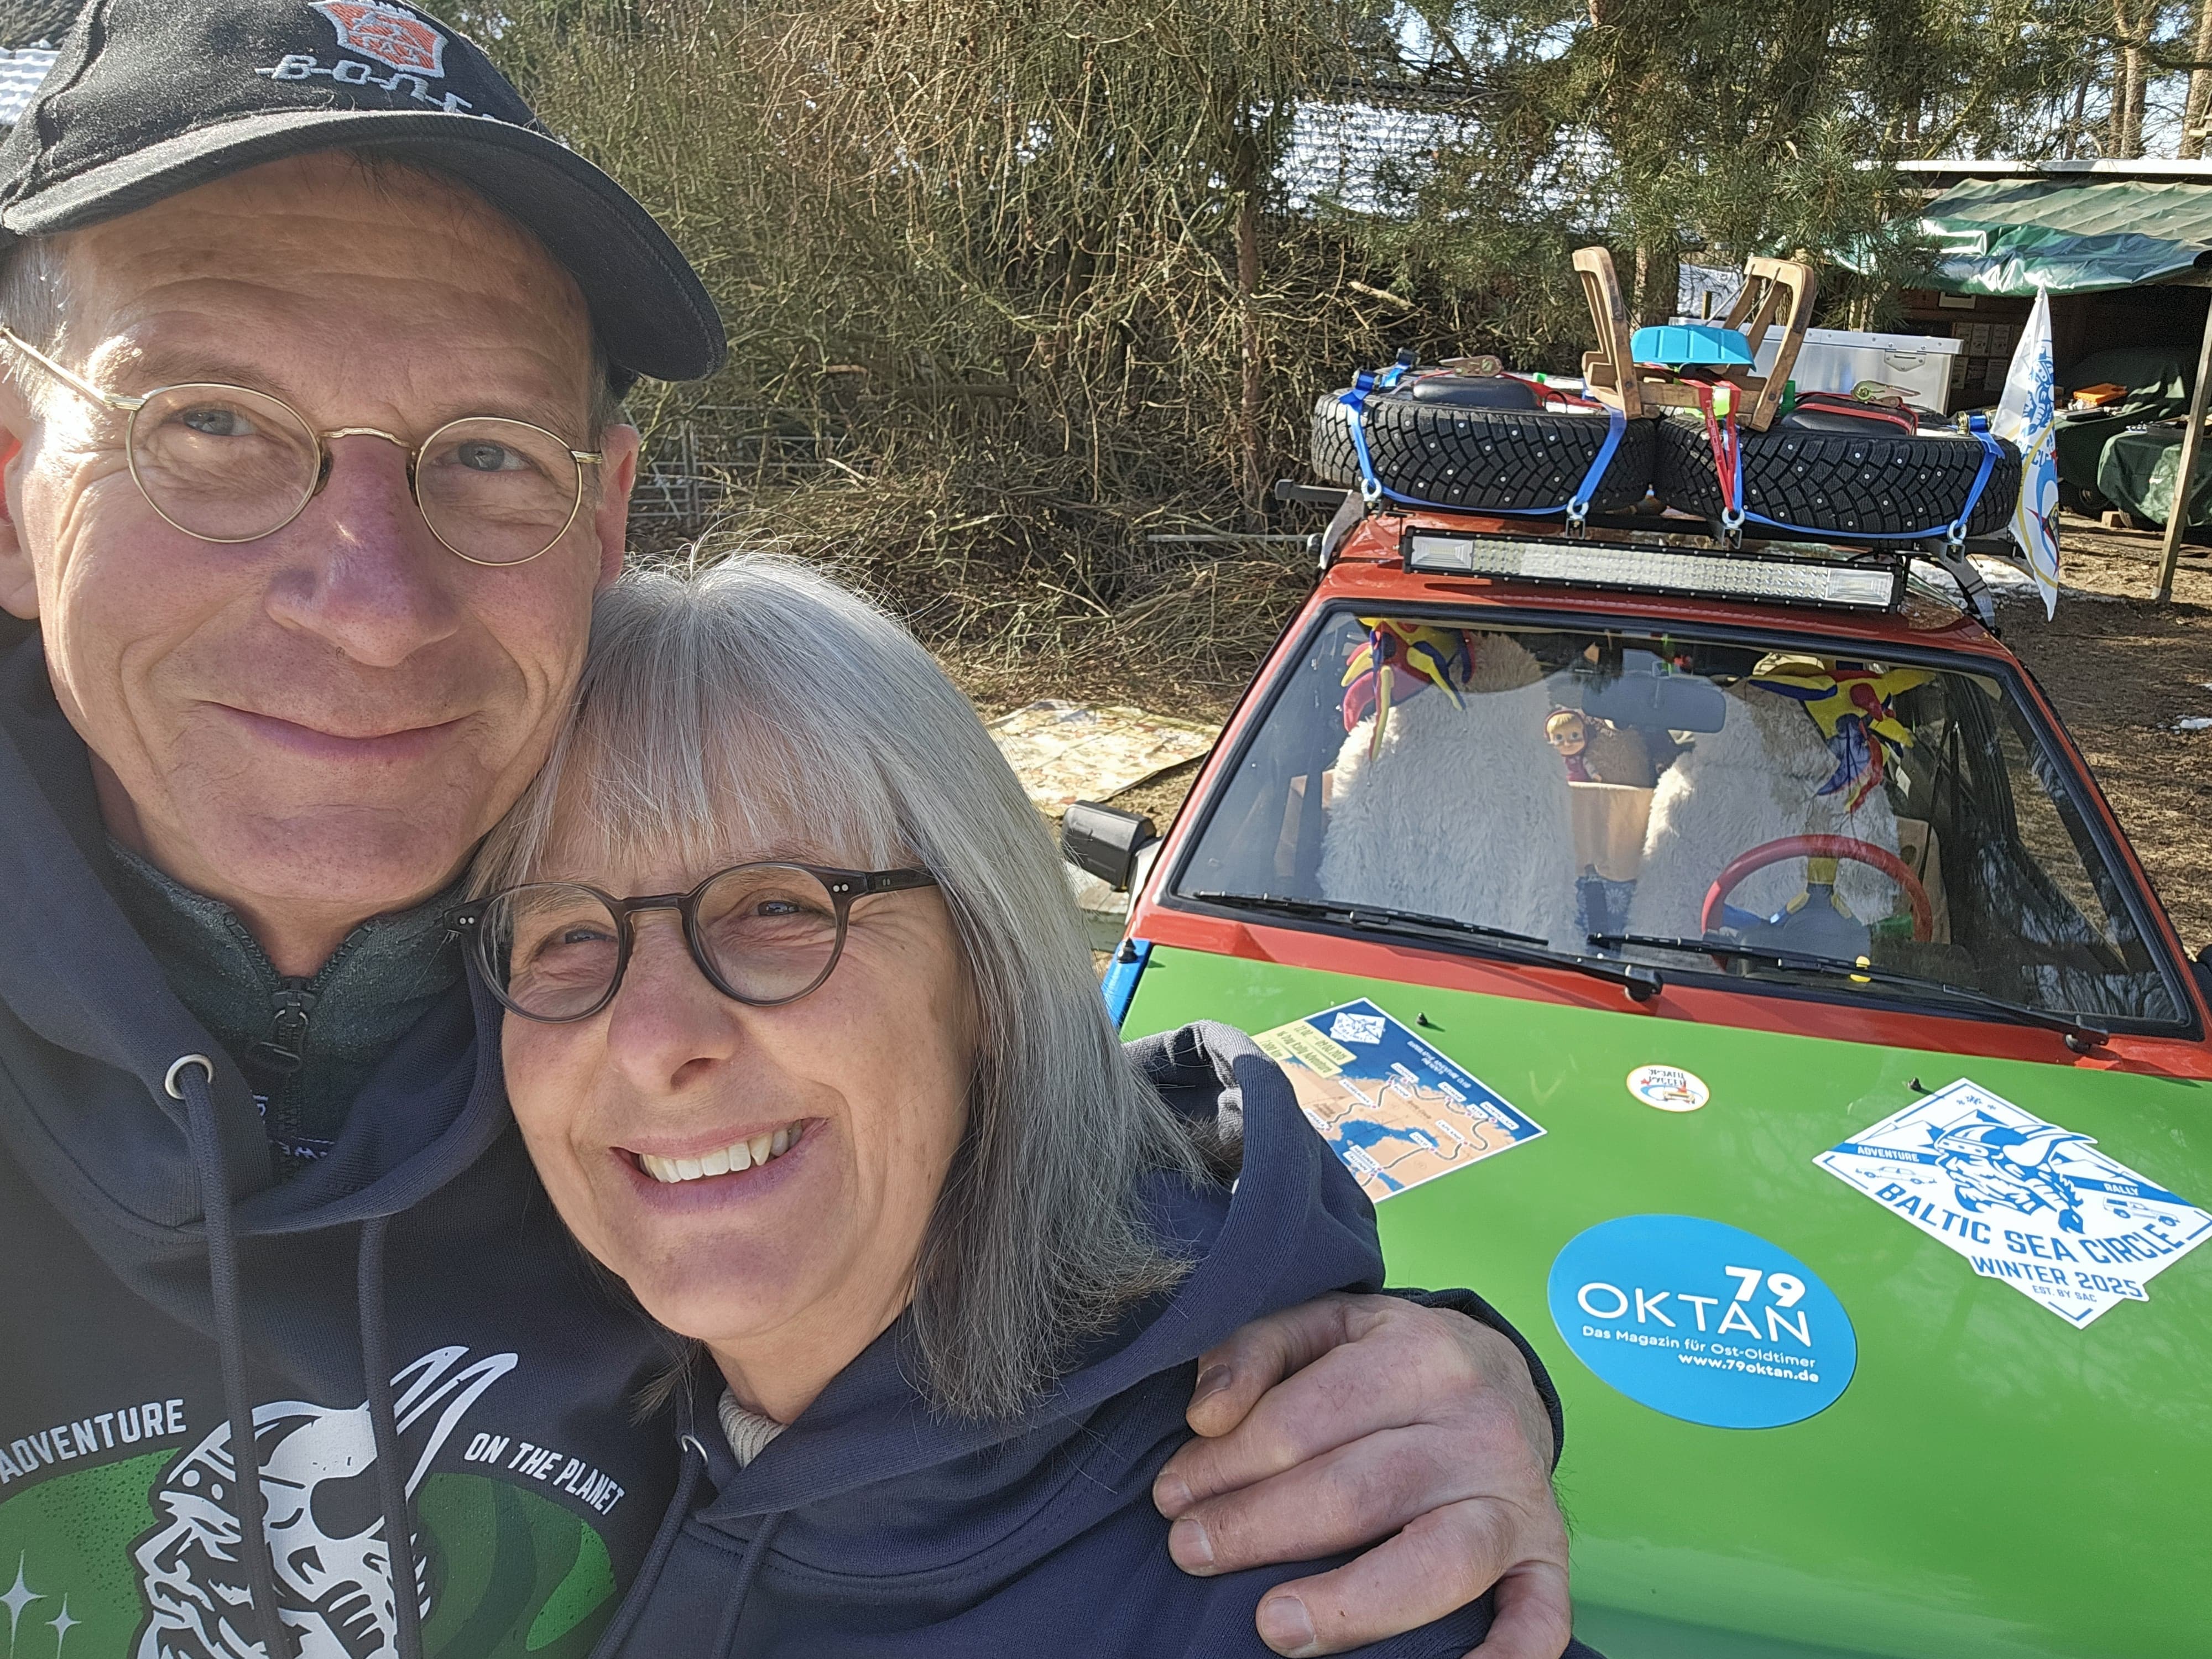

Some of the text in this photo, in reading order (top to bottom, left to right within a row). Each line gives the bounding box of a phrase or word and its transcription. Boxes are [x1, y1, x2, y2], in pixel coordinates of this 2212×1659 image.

[1857, 1145, 1919, 1162] ADVENTURE
[2103, 1182, 2140, 1197] RALLY
[1875, 1183, 2185, 1264] BALTIC SEA CIRCLE
[1725, 1265, 1806, 1308] 79
[1971, 1255, 2143, 1298] WINTER 2025
[2032, 1285, 2097, 1302] EST. BY SAC
[1577, 1283, 1812, 1347] OKTAN
[1583, 1326, 1815, 1368] Das Magazin für Ost-Oldtimer
[1678, 1354, 1819, 1383] www.79oktan.de
[0, 1399, 186, 1484] ADVENTURE
[465, 1433, 625, 1515] ON THE PLANET
